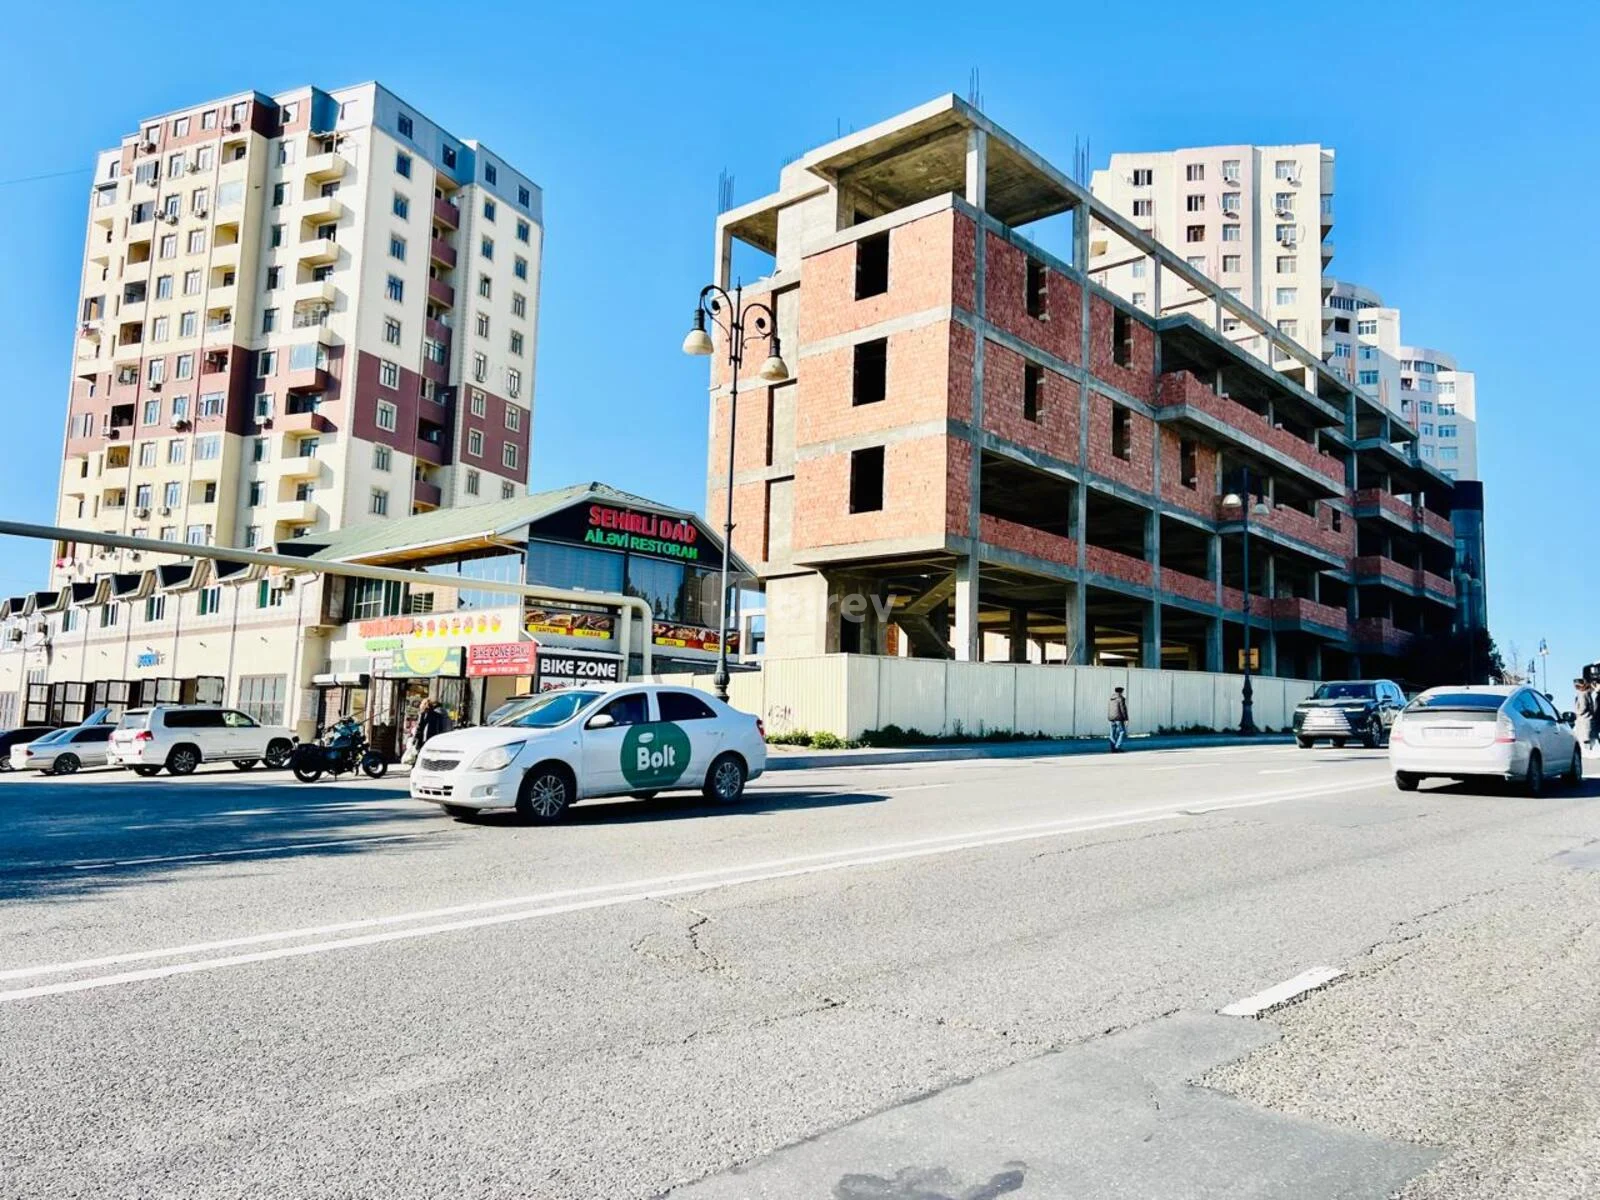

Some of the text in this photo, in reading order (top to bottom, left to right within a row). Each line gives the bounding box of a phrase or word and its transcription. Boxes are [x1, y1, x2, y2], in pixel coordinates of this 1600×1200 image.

[660, 520, 697, 543] DAD
[630, 535, 699, 559] RESTORAN
[489, 645, 509, 657] ZONE
[540, 658, 617, 678] BIKE ZONE
[636, 744, 676, 772] Bolt
